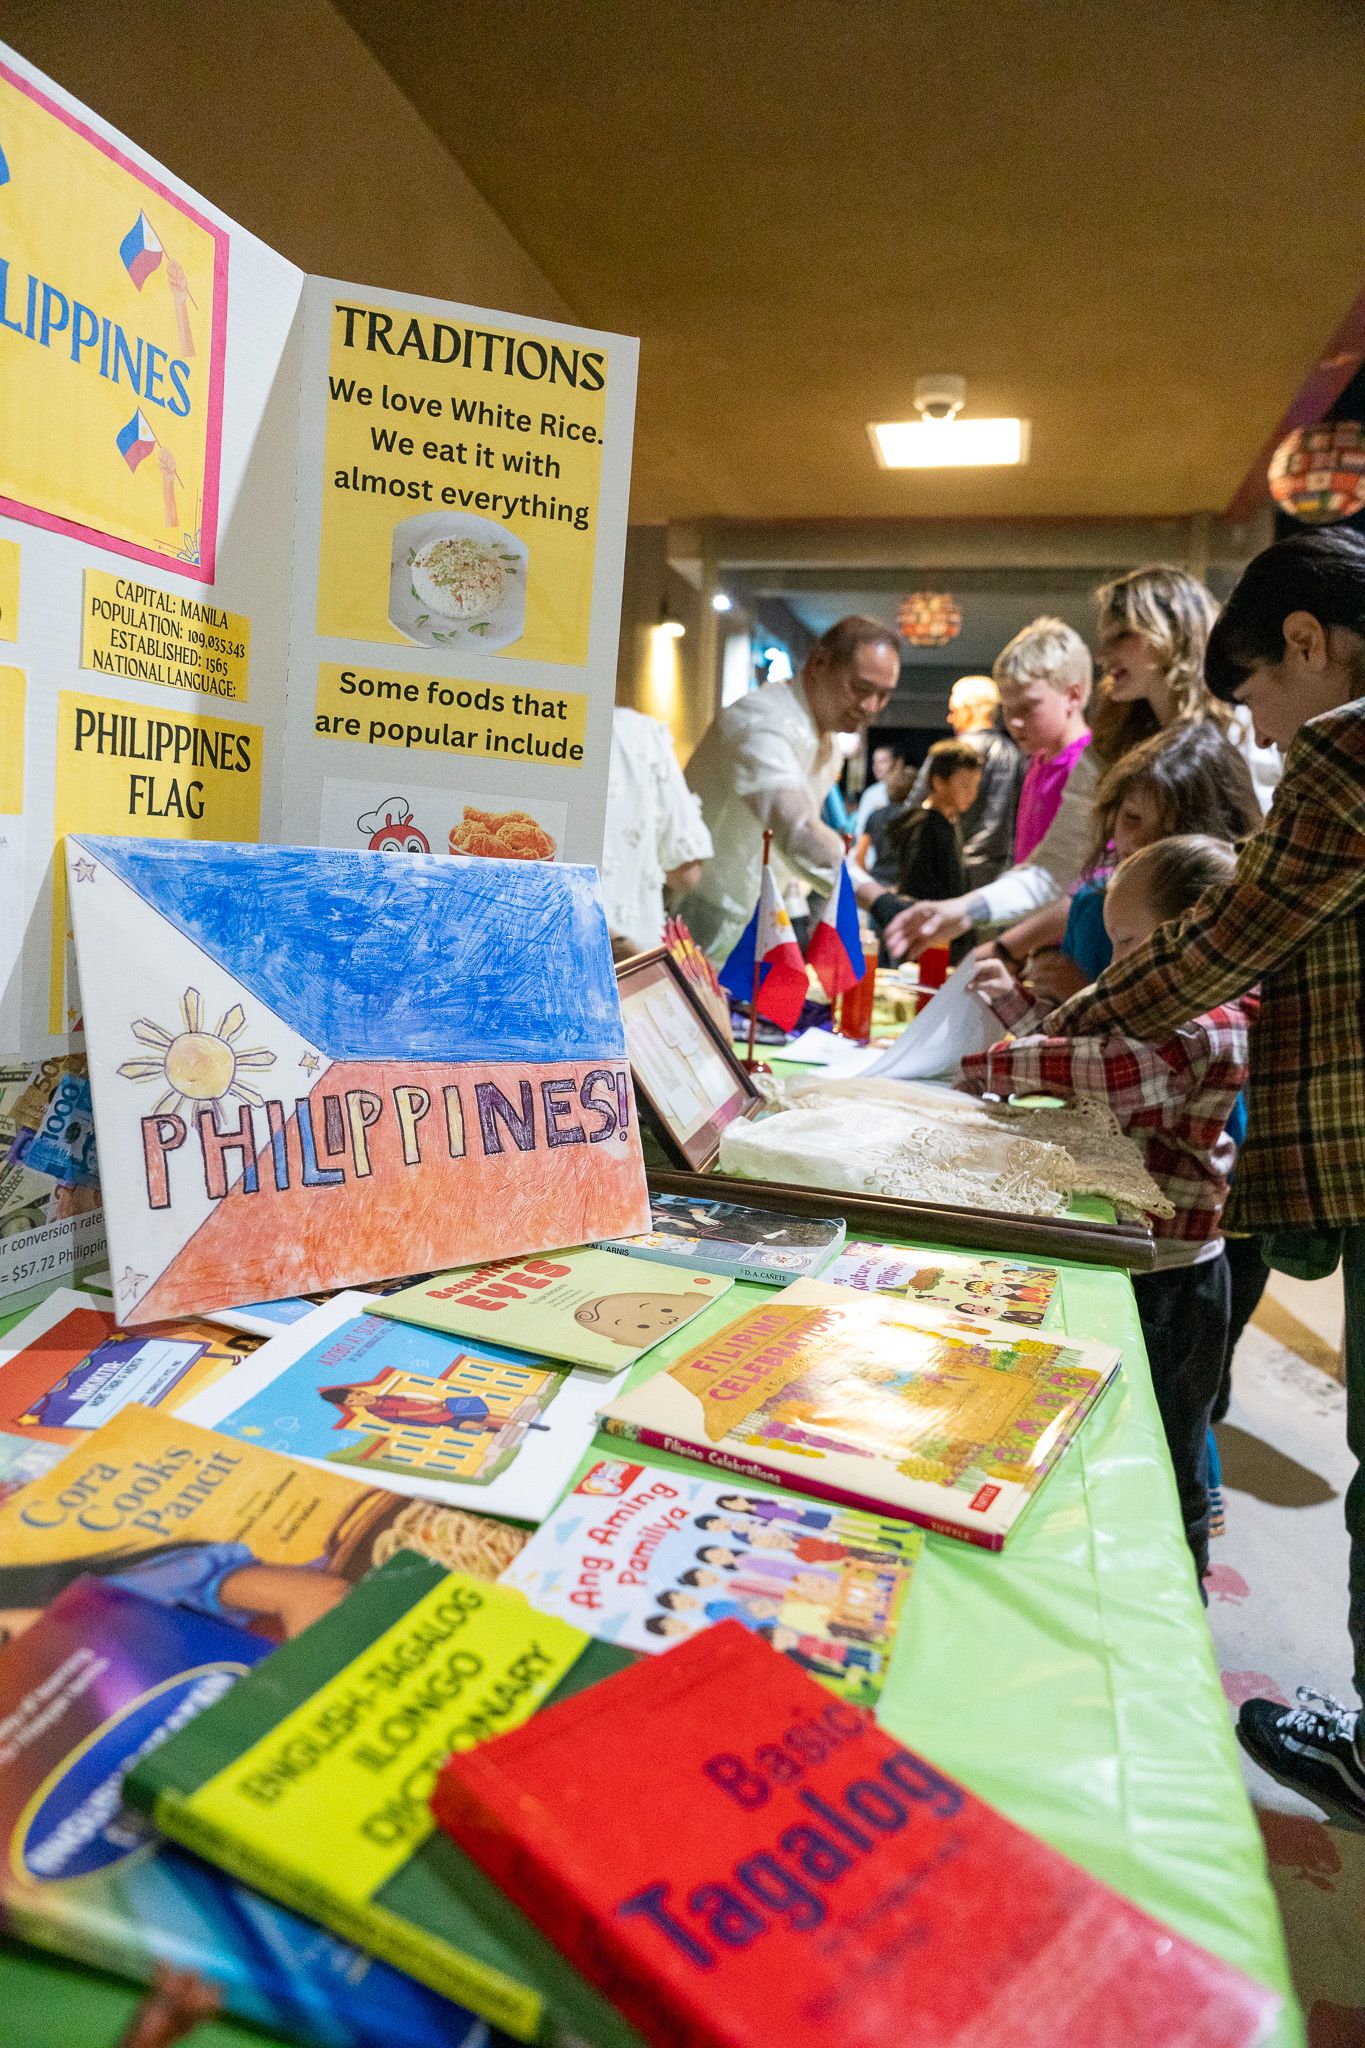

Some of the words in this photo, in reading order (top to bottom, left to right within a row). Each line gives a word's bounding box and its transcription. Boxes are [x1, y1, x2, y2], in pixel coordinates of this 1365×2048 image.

[335, 305, 605, 391] TRADITIONS
[329, 376, 373, 406] We
[383, 385, 442, 417] love
[451, 398, 532, 433] White
[540, 413, 604, 445] Rice.
[371, 427, 414, 455] We
[422, 440, 467, 465] eat
[475, 443, 494, 469] it
[503, 451, 561, 479] with
[334, 466, 433, 502] almost
[441, 486, 589, 531] everything
[91, 597, 183, 639] POPULATION:
[116, 580, 176, 613] CAPITAL:
[180, 600, 229, 630] MANILA
[93, 649, 166, 683] NATIONAL
[168, 667, 236, 698] LANGUAGE:
[110, 628, 201, 667] ESTABLISHED:
[205, 658, 228, 676] 1565
[339, 671, 420, 702] Some
[428, 681, 505, 712] foods
[512, 693, 568, 720] that
[74, 708, 251, 773] PHILIPPINES
[314, 714, 361, 736] are
[369, 718, 478, 749] popular
[485, 728, 584, 761] include
[129, 774, 205, 820] FLAG
[33, 1056, 64, 1091] 50
[40, 1083, 81, 1140] 1000
[141, 1070, 630, 1210] PHILIPPINES!
[11, 1221, 77, 1252] conversion
[12, 1255, 55, 1283] $57.72
[59, 1239, 108, 1265] Philippin
[606, 1246, 630, 1256] ARNIS
[760, 1272, 787, 1281] CAÑETE
[850, 1256, 885, 1291] Kulturan
[690, 1314, 789, 1373] FILIPINO
[708, 1308, 846, 1401] CELEBRATIONS
[664, 1437, 704, 1460] Filipino
[708, 1452, 781, 1483] Celebrations
[20, 1462, 123, 1529] Cora
[77, 1445, 193, 1532] Cooks
[132, 1450, 243, 1537] Pancit
[588, 1482, 679, 1547] Aming
[618, 1506, 689, 1588] Pamilya
[569, 1556, 614, 1611] Ang
[352, 1651, 484, 1773] ILONGO
[704, 1702, 866, 1811] Basic
[617, 1749, 965, 1968] Tagalog
